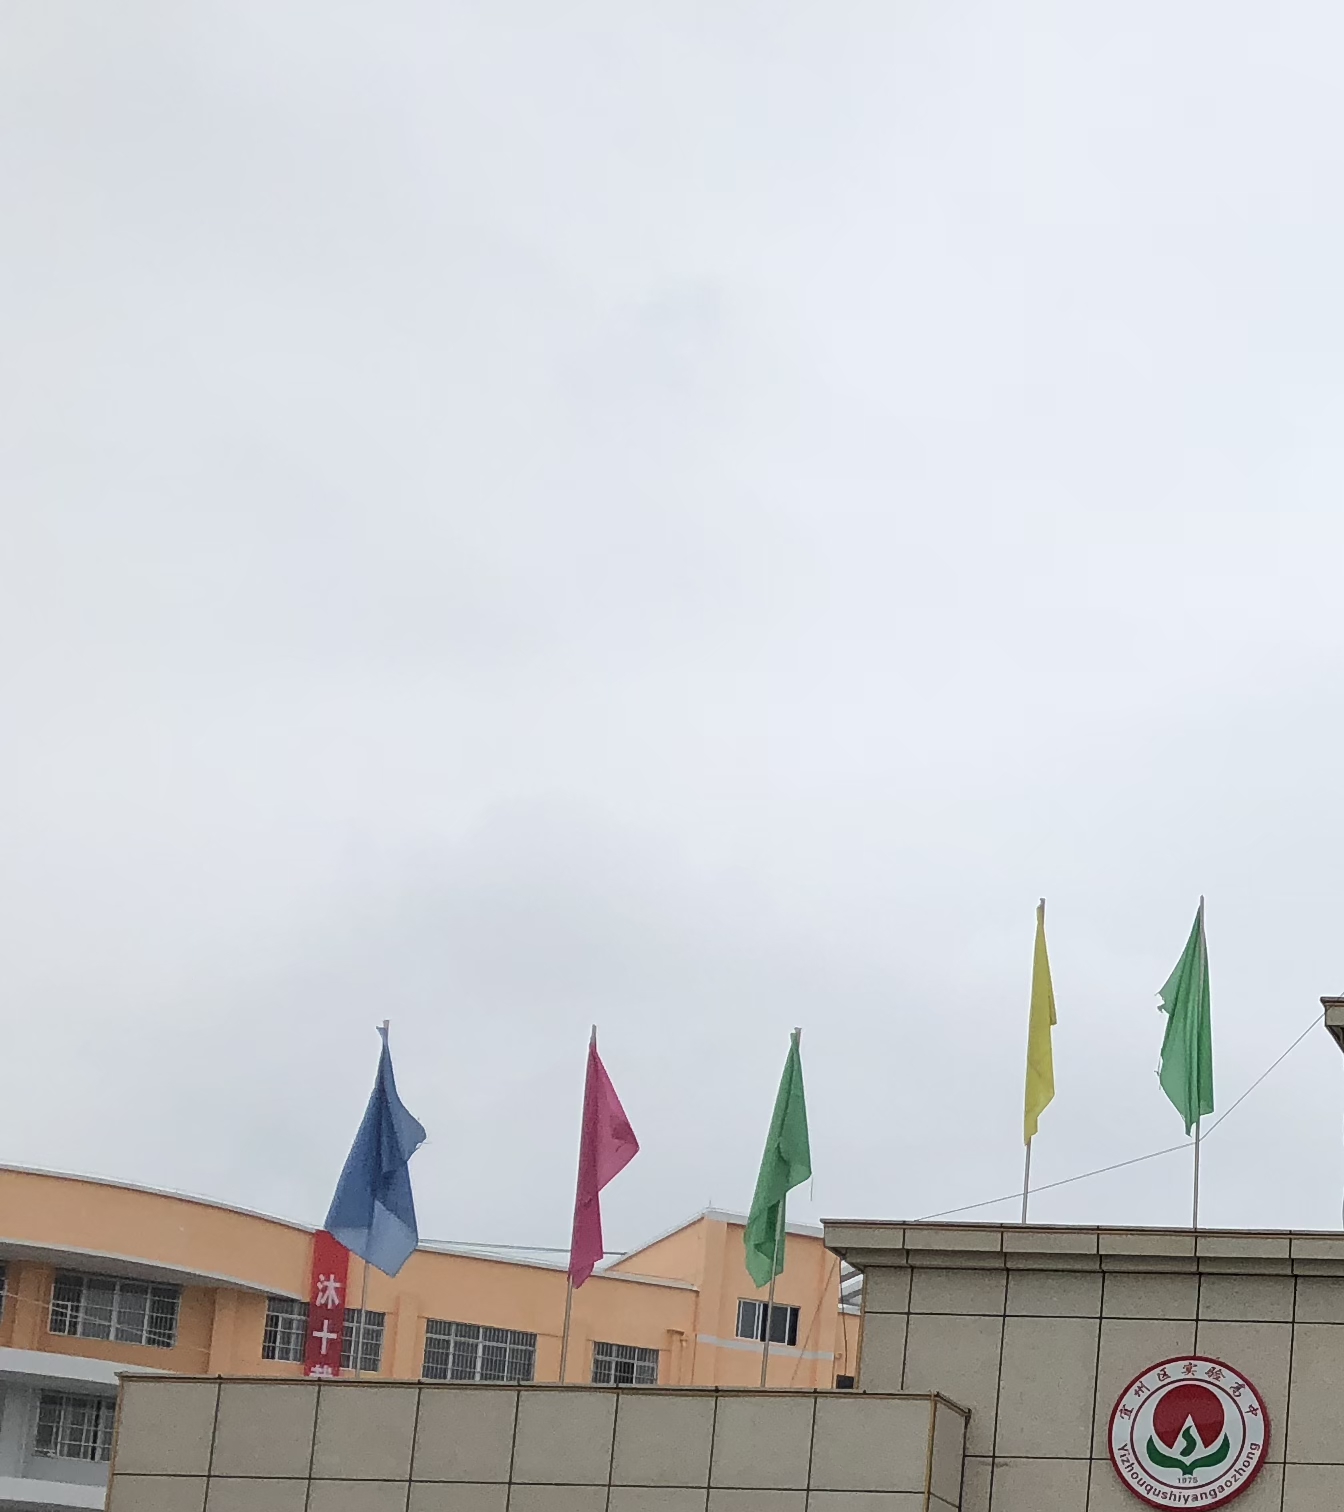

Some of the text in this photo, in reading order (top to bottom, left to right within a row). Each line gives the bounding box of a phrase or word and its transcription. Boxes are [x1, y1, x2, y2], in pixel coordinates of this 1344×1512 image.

[1118, 1361, 1260, 1421] 宜州区实验高中
